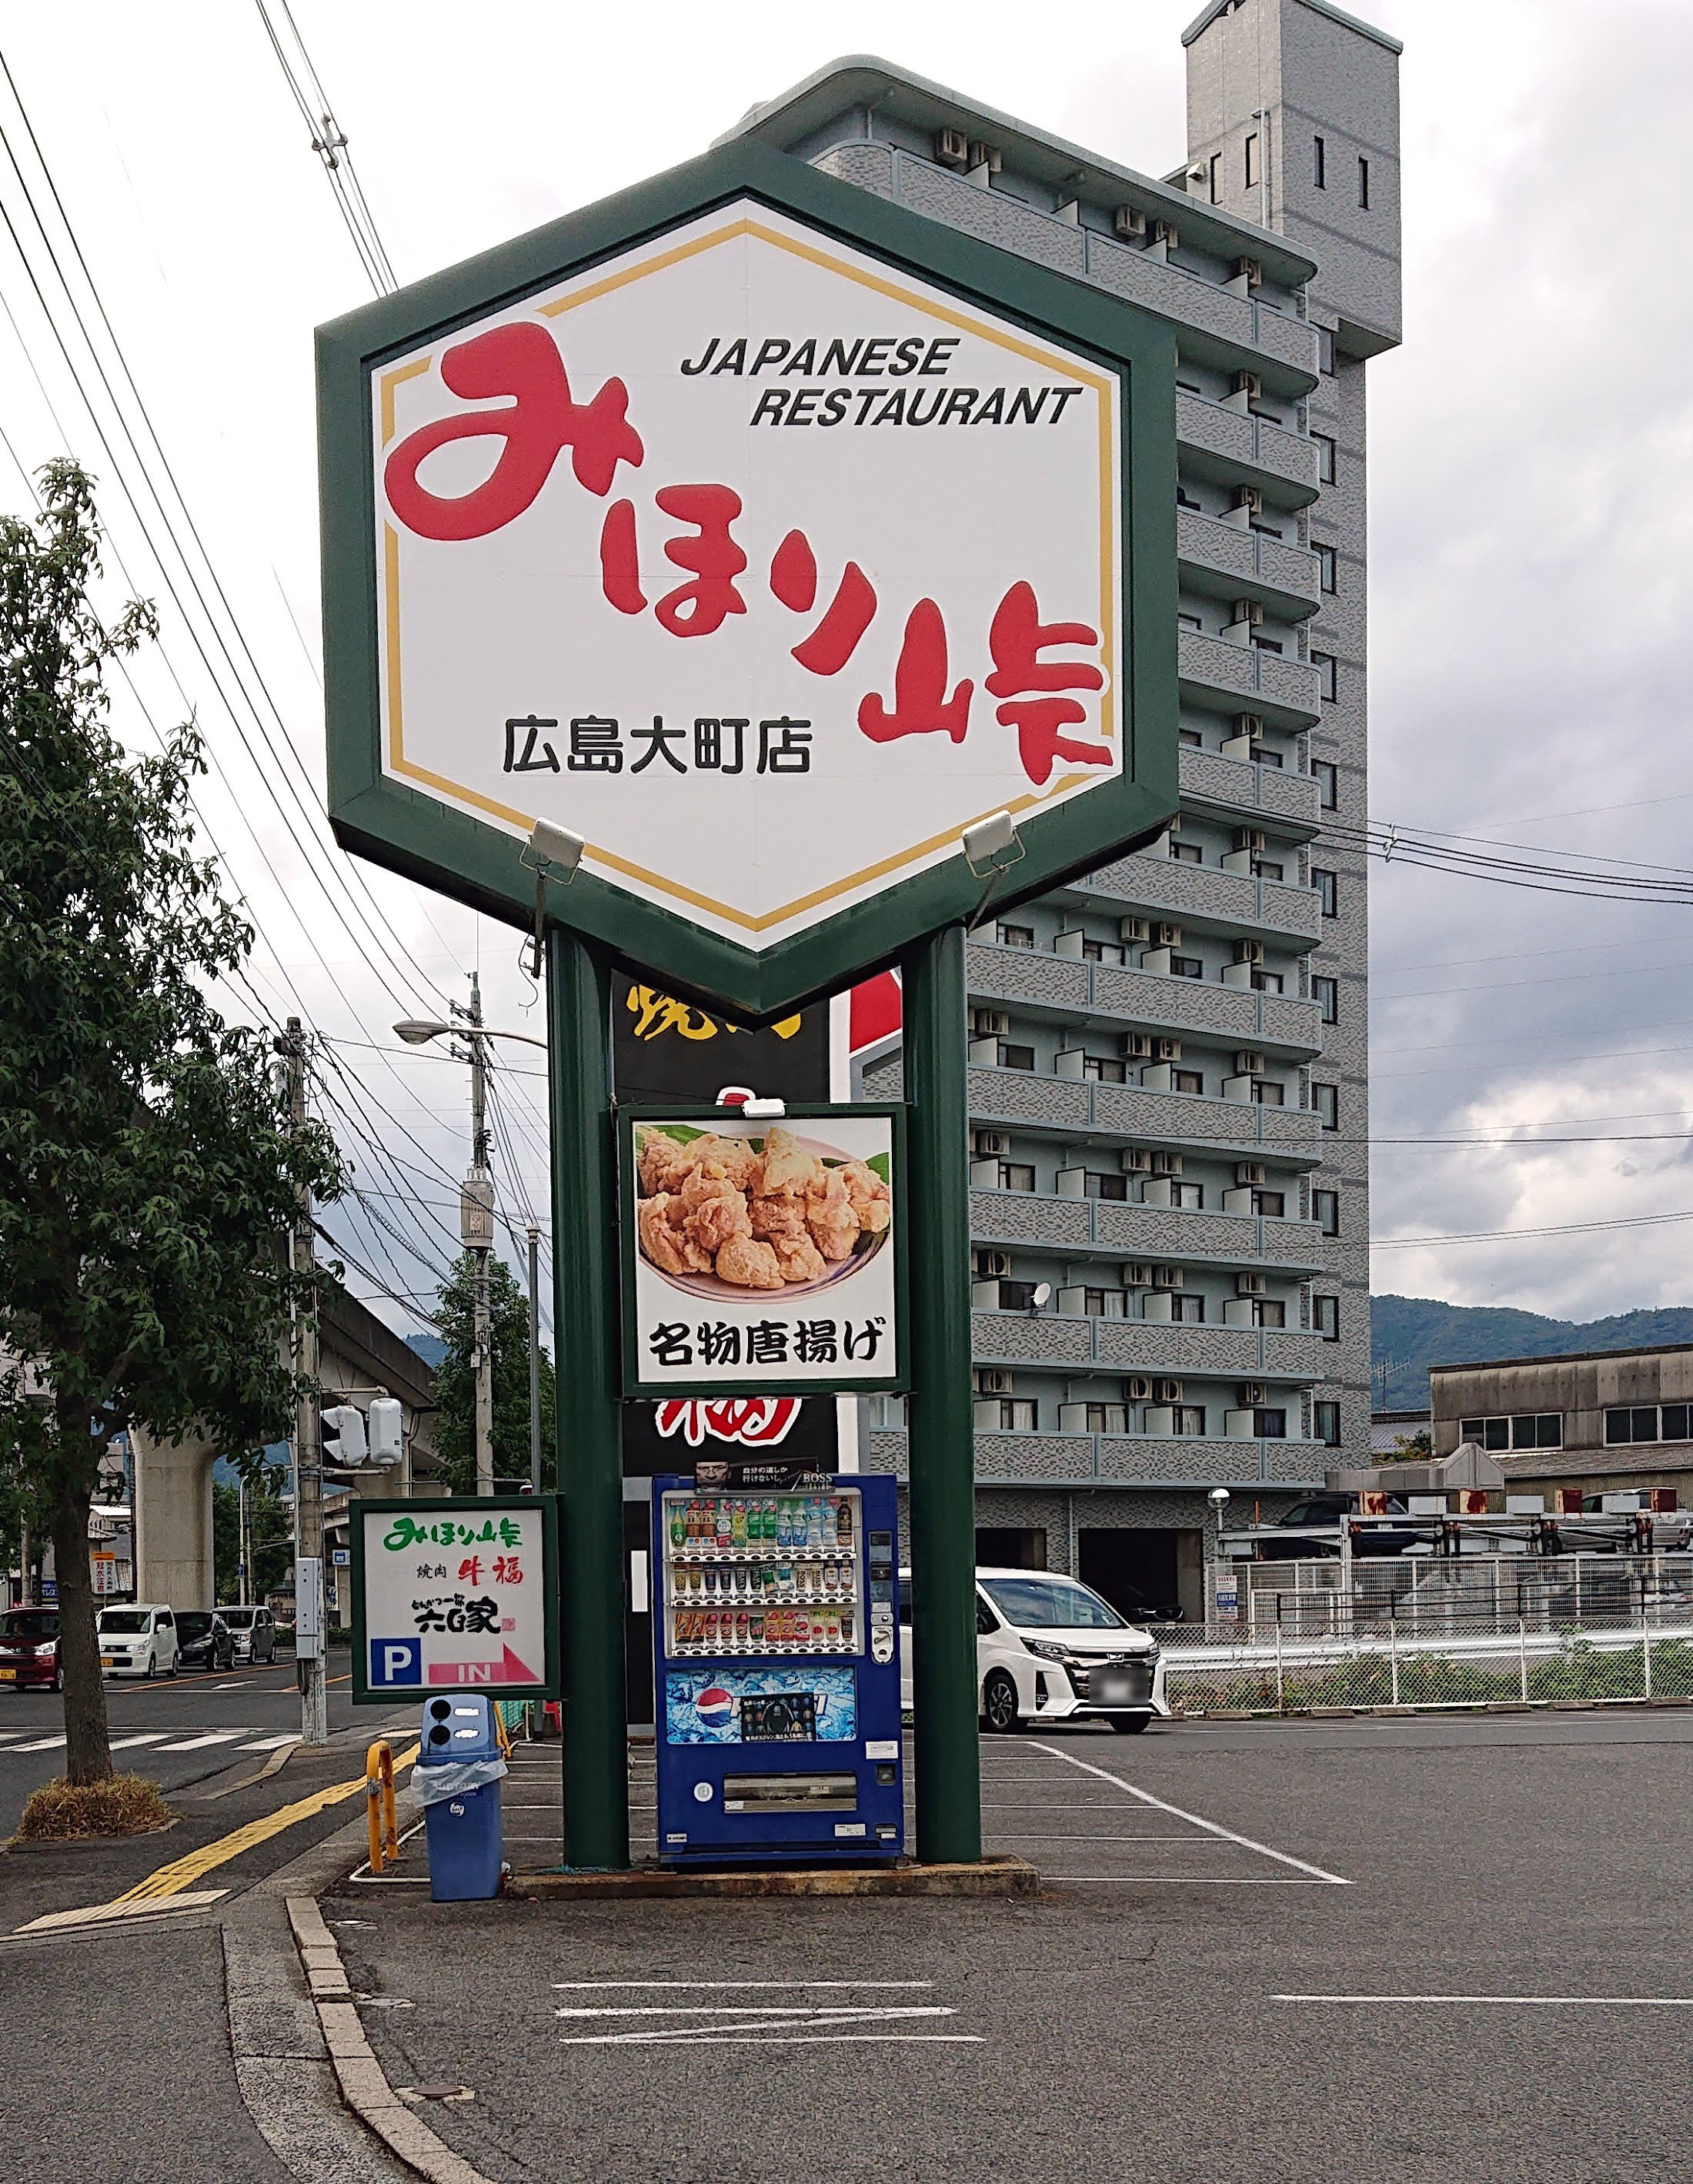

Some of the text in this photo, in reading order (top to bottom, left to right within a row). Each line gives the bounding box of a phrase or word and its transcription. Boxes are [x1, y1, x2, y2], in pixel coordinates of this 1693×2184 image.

[681, 338, 960, 376] JAPANESE
[750, 388, 1084, 426] RESTAURANT
[385, 322, 1113, 785] みほり峠
[503, 715, 812, 774] 広島大町店
[649, 1317, 886, 1366] 名物唐揚げ
[803, 1473, 832, 1483] BOSS
[417, 1564, 446, 1578] 焼肉
[385, 1647, 412, 1680] P
[459, 1664, 490, 1681] IN
